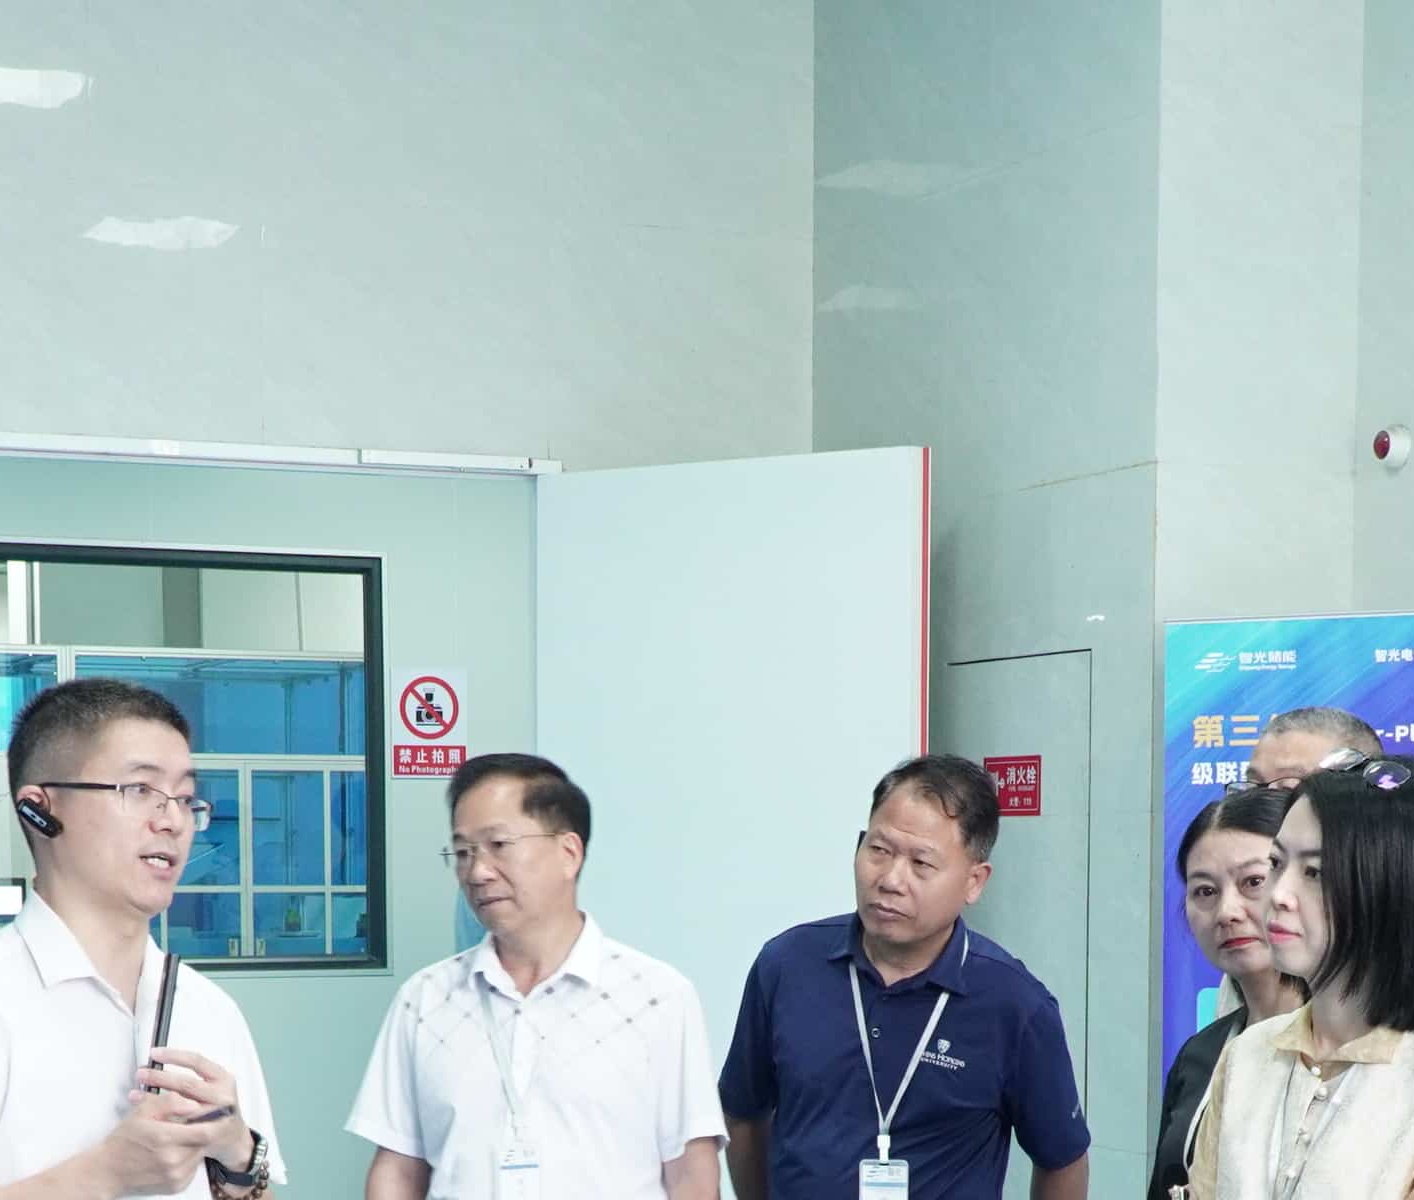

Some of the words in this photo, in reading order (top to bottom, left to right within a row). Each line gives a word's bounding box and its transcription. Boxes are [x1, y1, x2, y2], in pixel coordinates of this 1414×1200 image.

[1192, 714, 1277, 748] 第三
[399, 748, 461, 764] 禁止拍照
[399, 765, 410, 773] No
[1006, 765, 1036, 784] 消火栓
